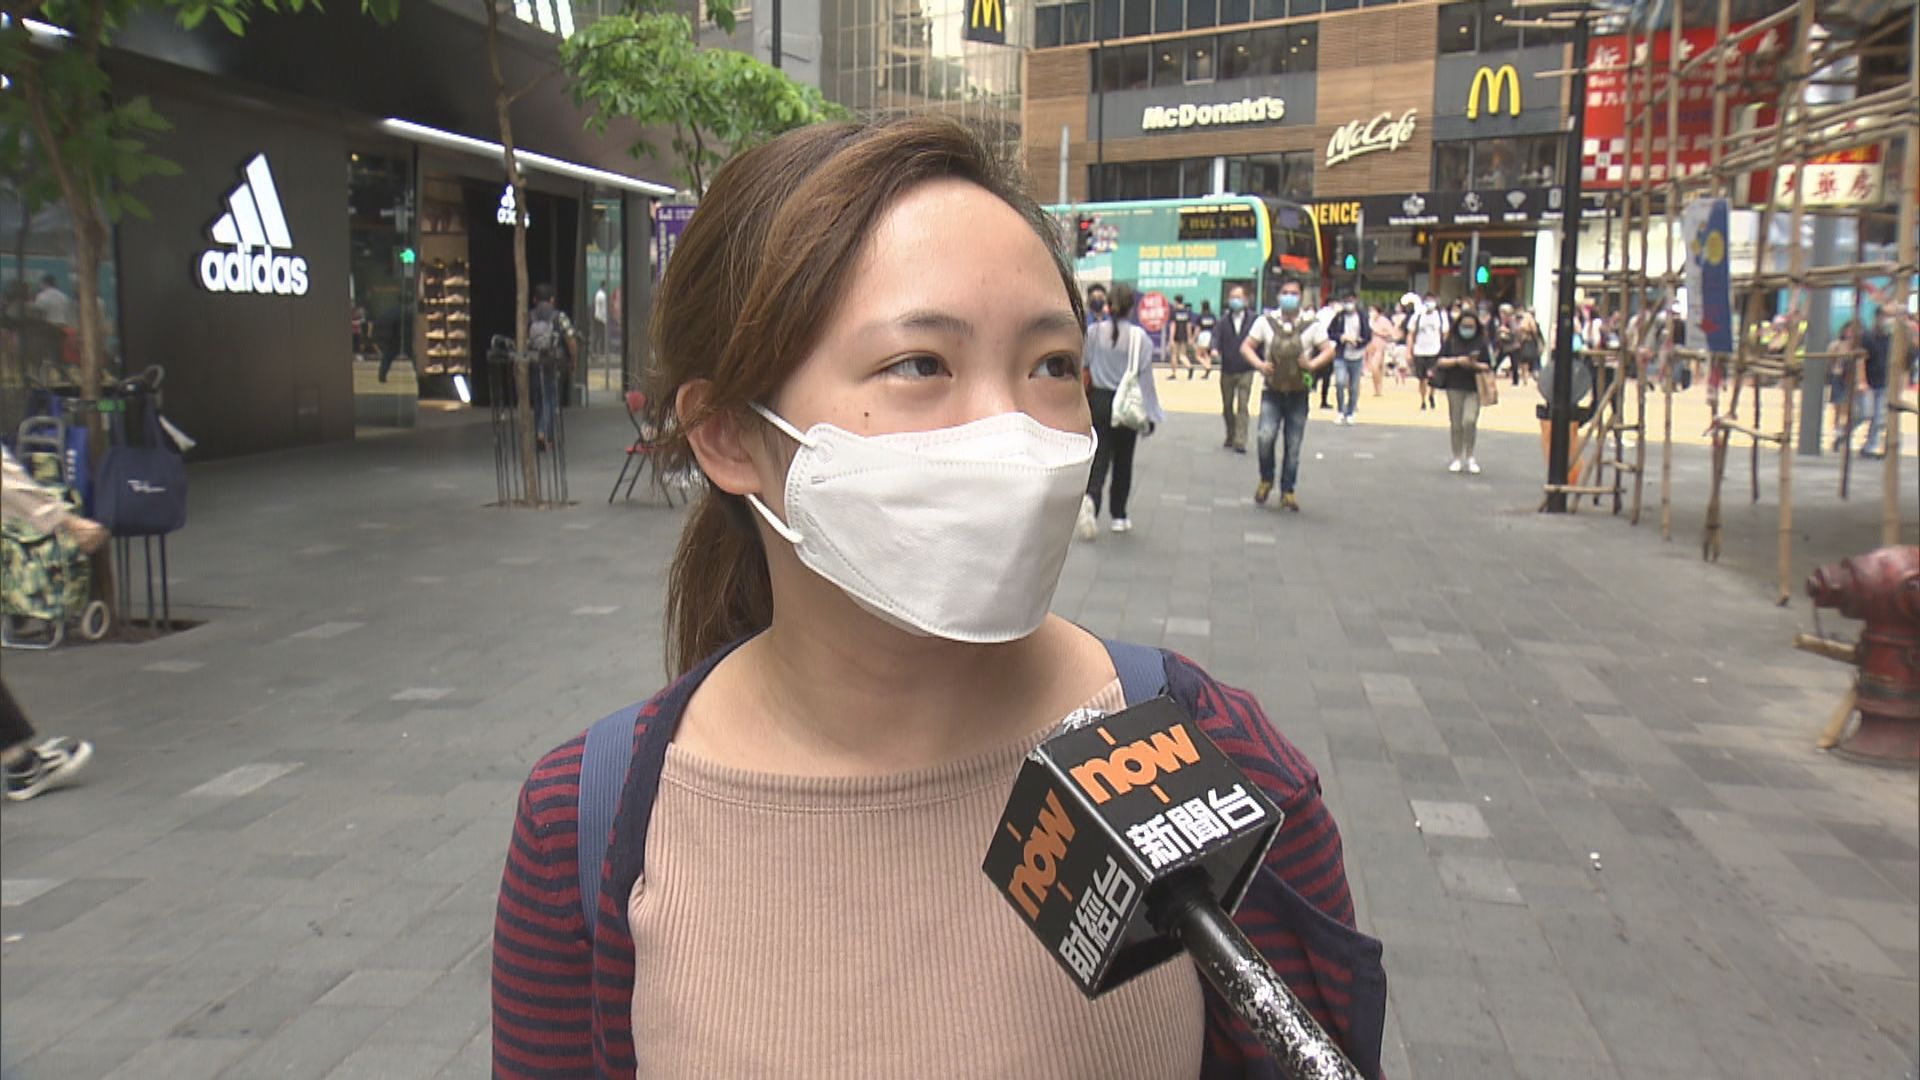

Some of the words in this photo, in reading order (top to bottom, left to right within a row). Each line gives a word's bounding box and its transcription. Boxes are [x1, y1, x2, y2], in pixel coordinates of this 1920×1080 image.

[1142, 97, 1285, 130] McDonald's
[1326, 108, 1417, 164] McCafé
[497, 207, 531, 229] adis
[199, 244, 310, 297] adidas
[1069, 724, 1201, 804] now
[1008, 788, 1076, 922] now
[1126, 784, 1266, 869] 新聞台
[1059, 854, 1138, 984] 財經台
